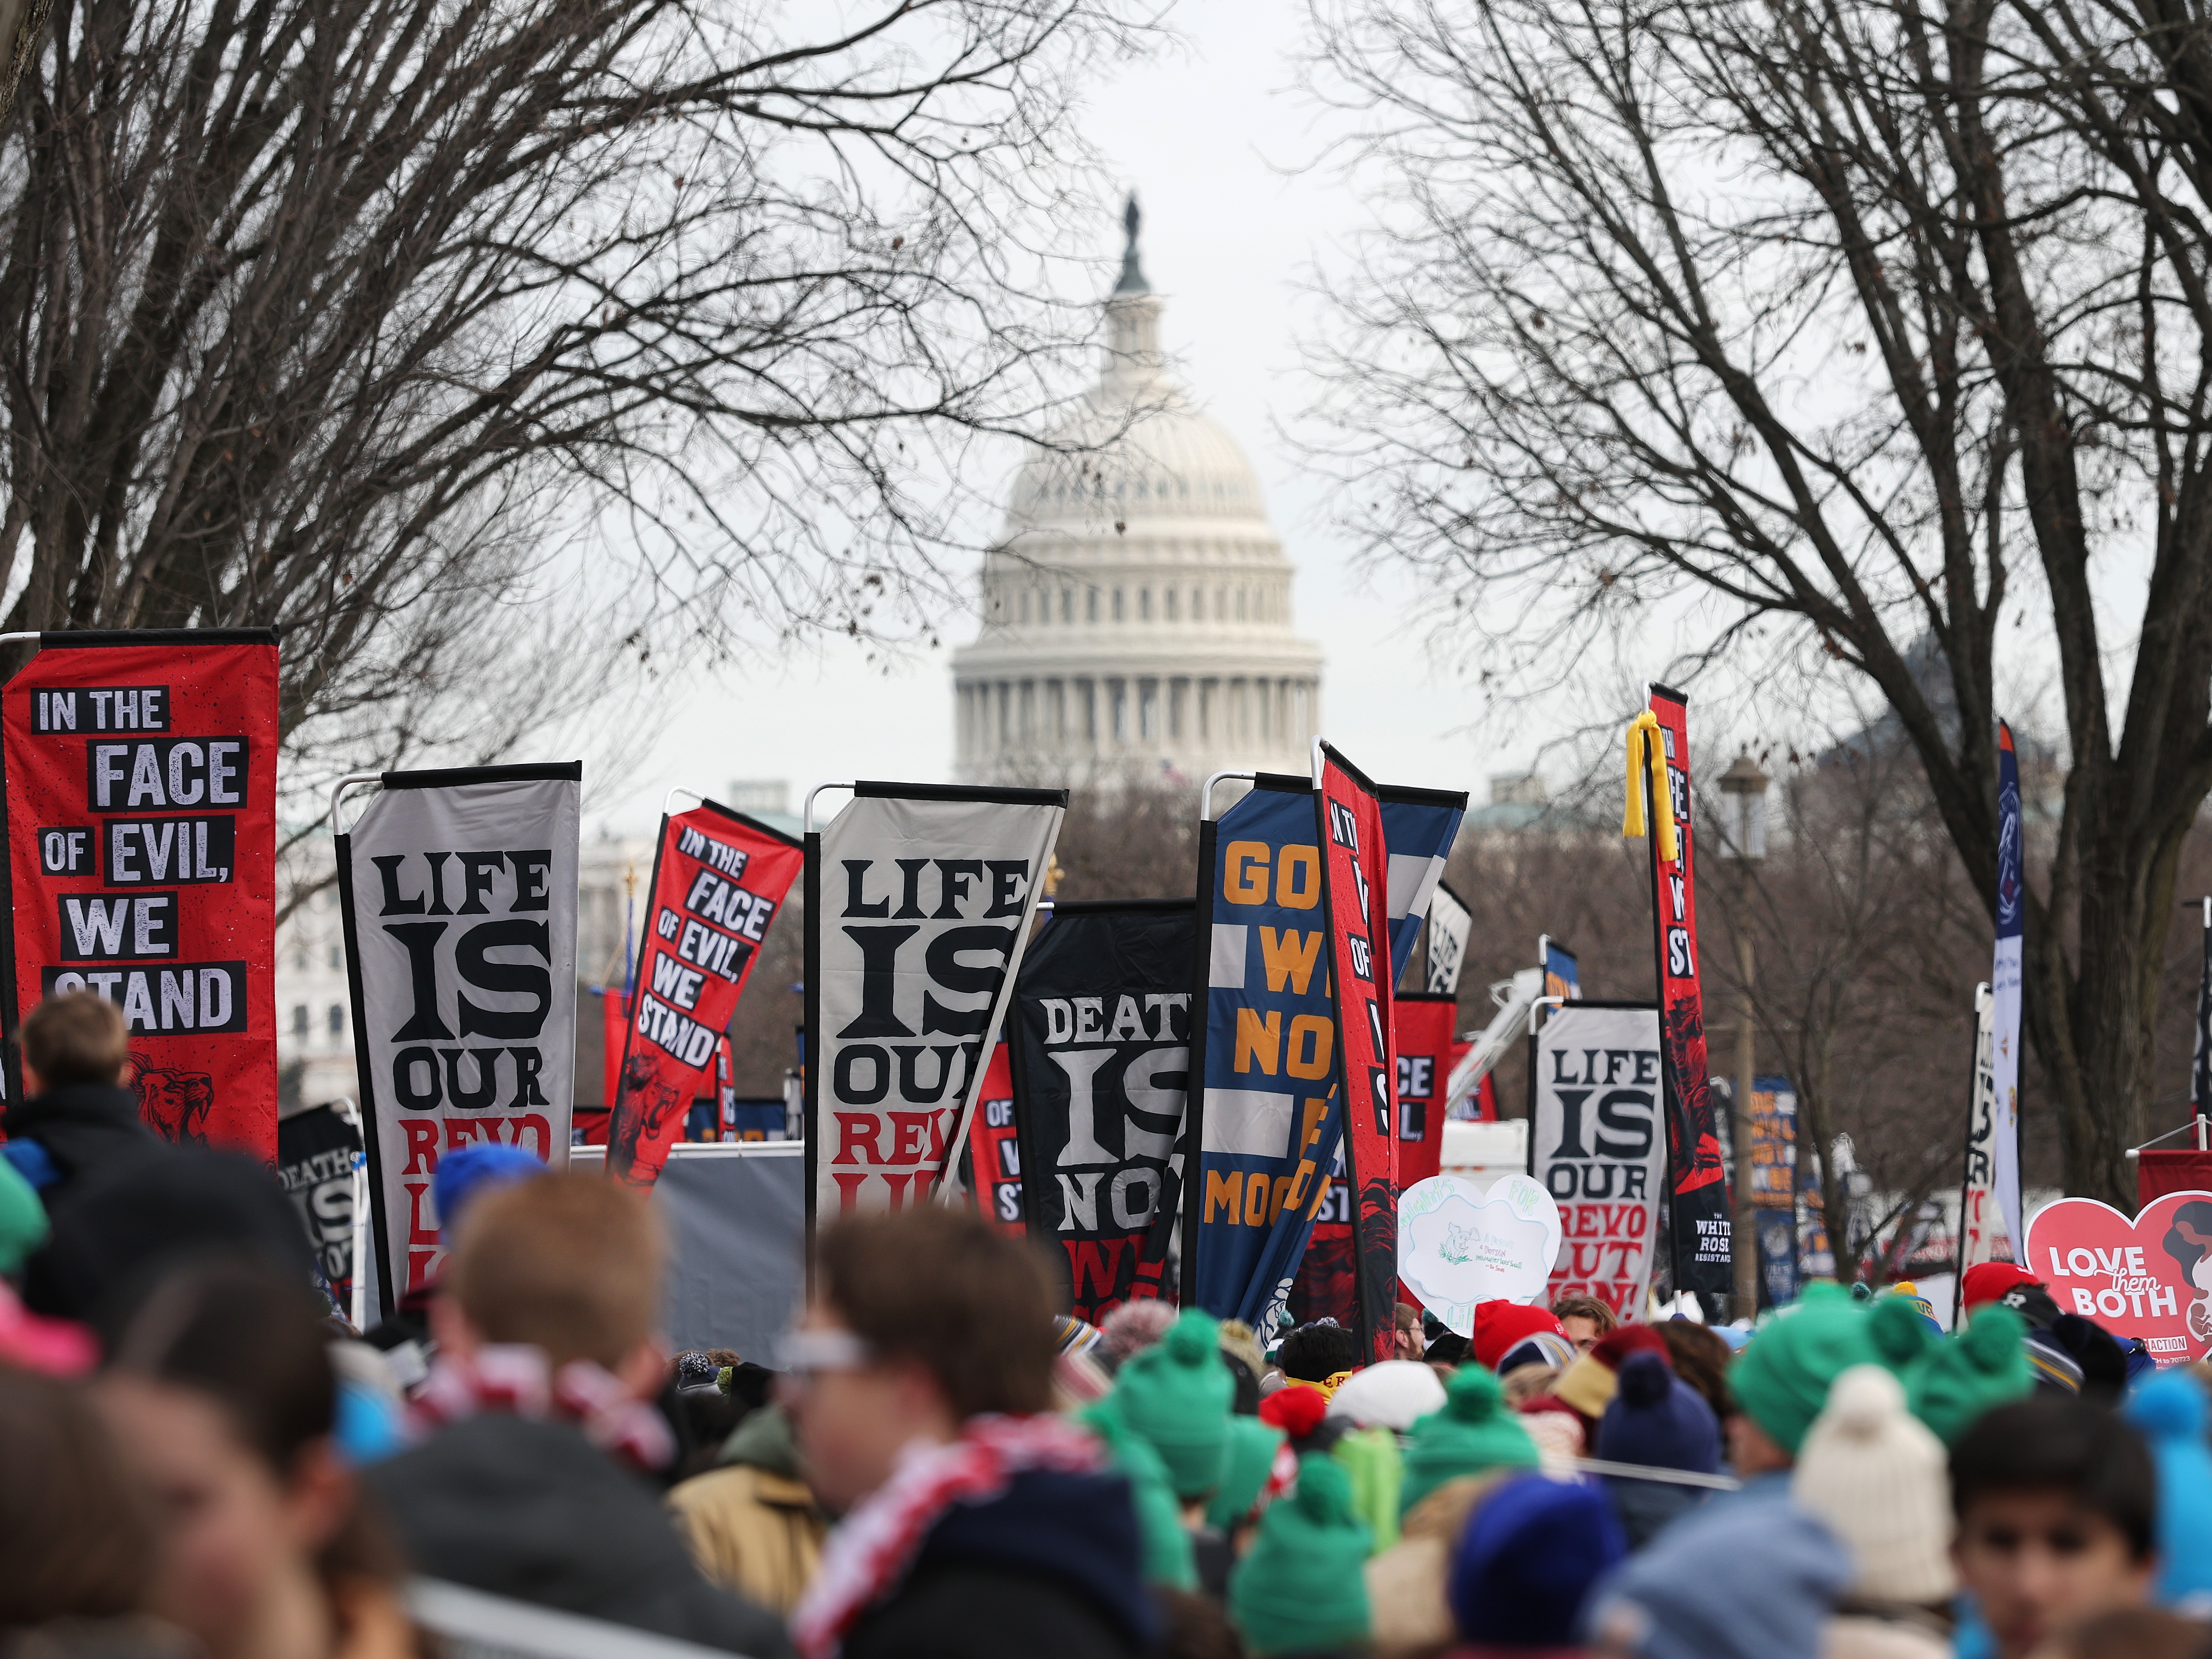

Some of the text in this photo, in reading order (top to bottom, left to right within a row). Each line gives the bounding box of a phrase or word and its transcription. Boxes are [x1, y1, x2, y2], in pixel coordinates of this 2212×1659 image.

[39, 690, 162, 730] IN THE
[96, 742, 240, 806] FACE
[45, 822, 228, 882] OF EVIL,
[679, 826, 747, 878] IN THE
[1223, 841, 1321, 910] GO
[370, 849, 552, 916] LIFE
[686, 871, 773, 941] FACE
[841, 859, 1029, 919] LIFE
[66, 897, 170, 955] WE
[658, 909, 738, 984] OF EVIL,
[382, 919, 552, 1043] IS
[655, 952, 704, 1010] WE
[836, 925, 1019, 1038] IS
[1350, 937, 1370, 978] OF
[638, 993, 715, 1067] STAND
[1039, 993, 1192, 1044] DEAT
[1234, 1008, 1334, 1080] NO
[393, 1046, 550, 1110] OUR
[1396, 1056, 1432, 1097] CE
[1551, 1050, 1660, 1084] LIFE
[986, 1100, 1013, 1127] OF
[1047, 1046, 1189, 1166] IS
[1549, 1089, 1655, 1159] IS
[1055, 1167, 1162, 1231] NO
[1547, 1163, 1647, 1200] OUR
[1695, 1220, 1731, 1235] WHITE
[1699, 1236, 1729, 1253] ROSE
[2049, 1247, 2146, 1277] LOVE
[2093, 1267, 2161, 1292] them
[2071, 1286, 2178, 1319] BOTH
[2151, 1338, 2186, 1350] ACTION
[2170, 1355, 2191, 1364] 70723
